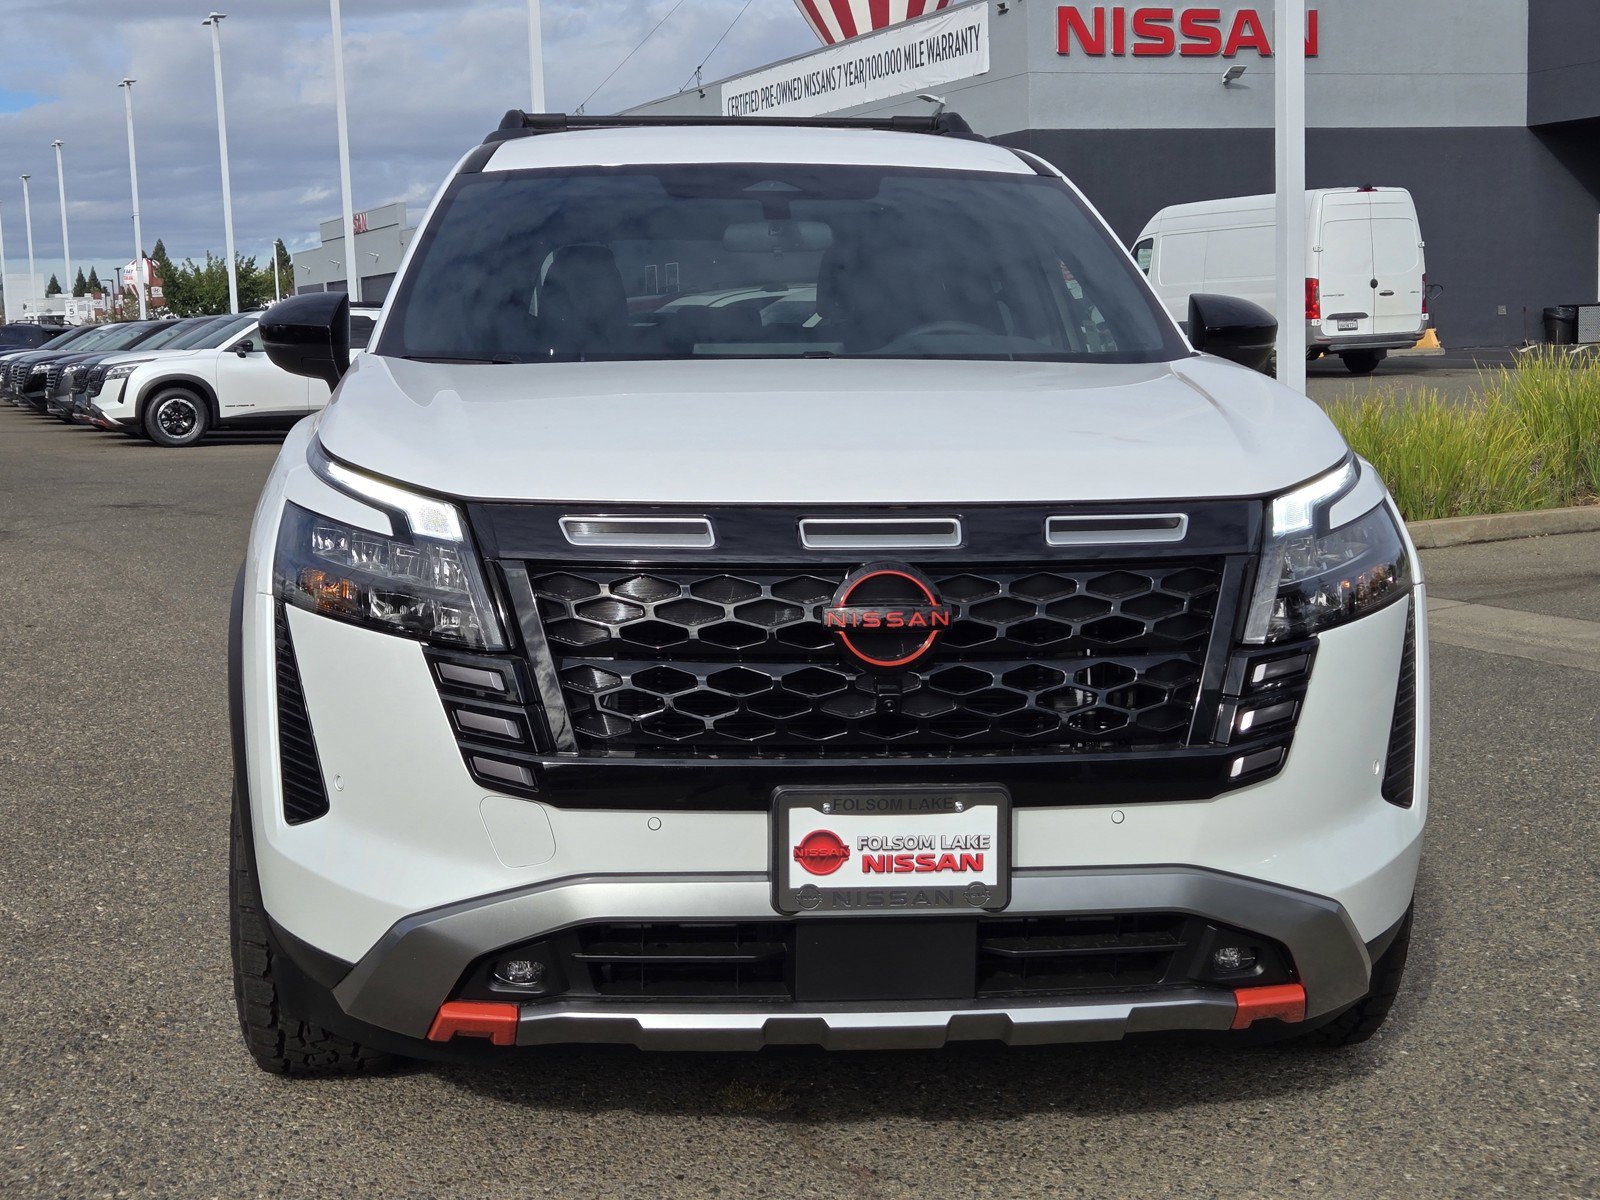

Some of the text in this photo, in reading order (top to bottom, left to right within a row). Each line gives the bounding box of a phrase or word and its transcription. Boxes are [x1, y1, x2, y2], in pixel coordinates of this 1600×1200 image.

[727, 22, 981, 117] CERTIFIED PRE-OWNED NISSANS 7 YEAR/100,000 MILE WARRANTY
[826, 610, 949, 629] NISSAN
[833, 796, 954, 812] FOLSOM LAKE
[857, 834, 991, 851] FOLSOM LAKE
[793, 847, 851, 858] NISSAN
[861, 852, 984, 874] NISSAN
[831, 888, 954, 908] NISSAN
